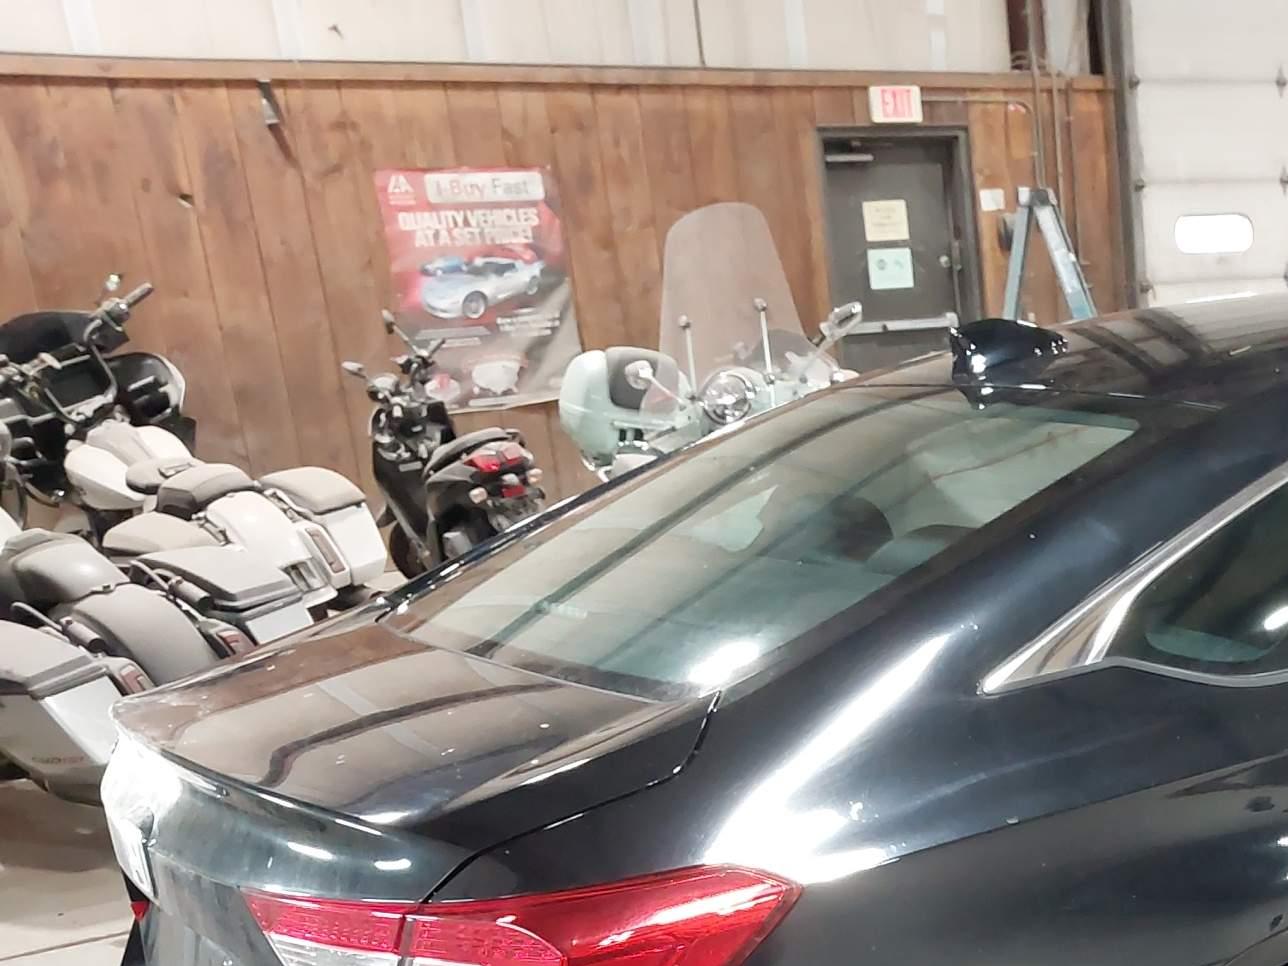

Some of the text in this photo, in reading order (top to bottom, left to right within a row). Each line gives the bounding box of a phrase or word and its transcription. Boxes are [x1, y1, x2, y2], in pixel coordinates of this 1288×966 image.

[880, 88, 914, 118] EXIT
[491, 177, 529, 196] Fast
[398, 207, 540, 230] QUALITY VEHICLES
[415, 228, 436, 248] AT
[438, 228, 451, 247] A
[451, 227, 481, 246] SET
